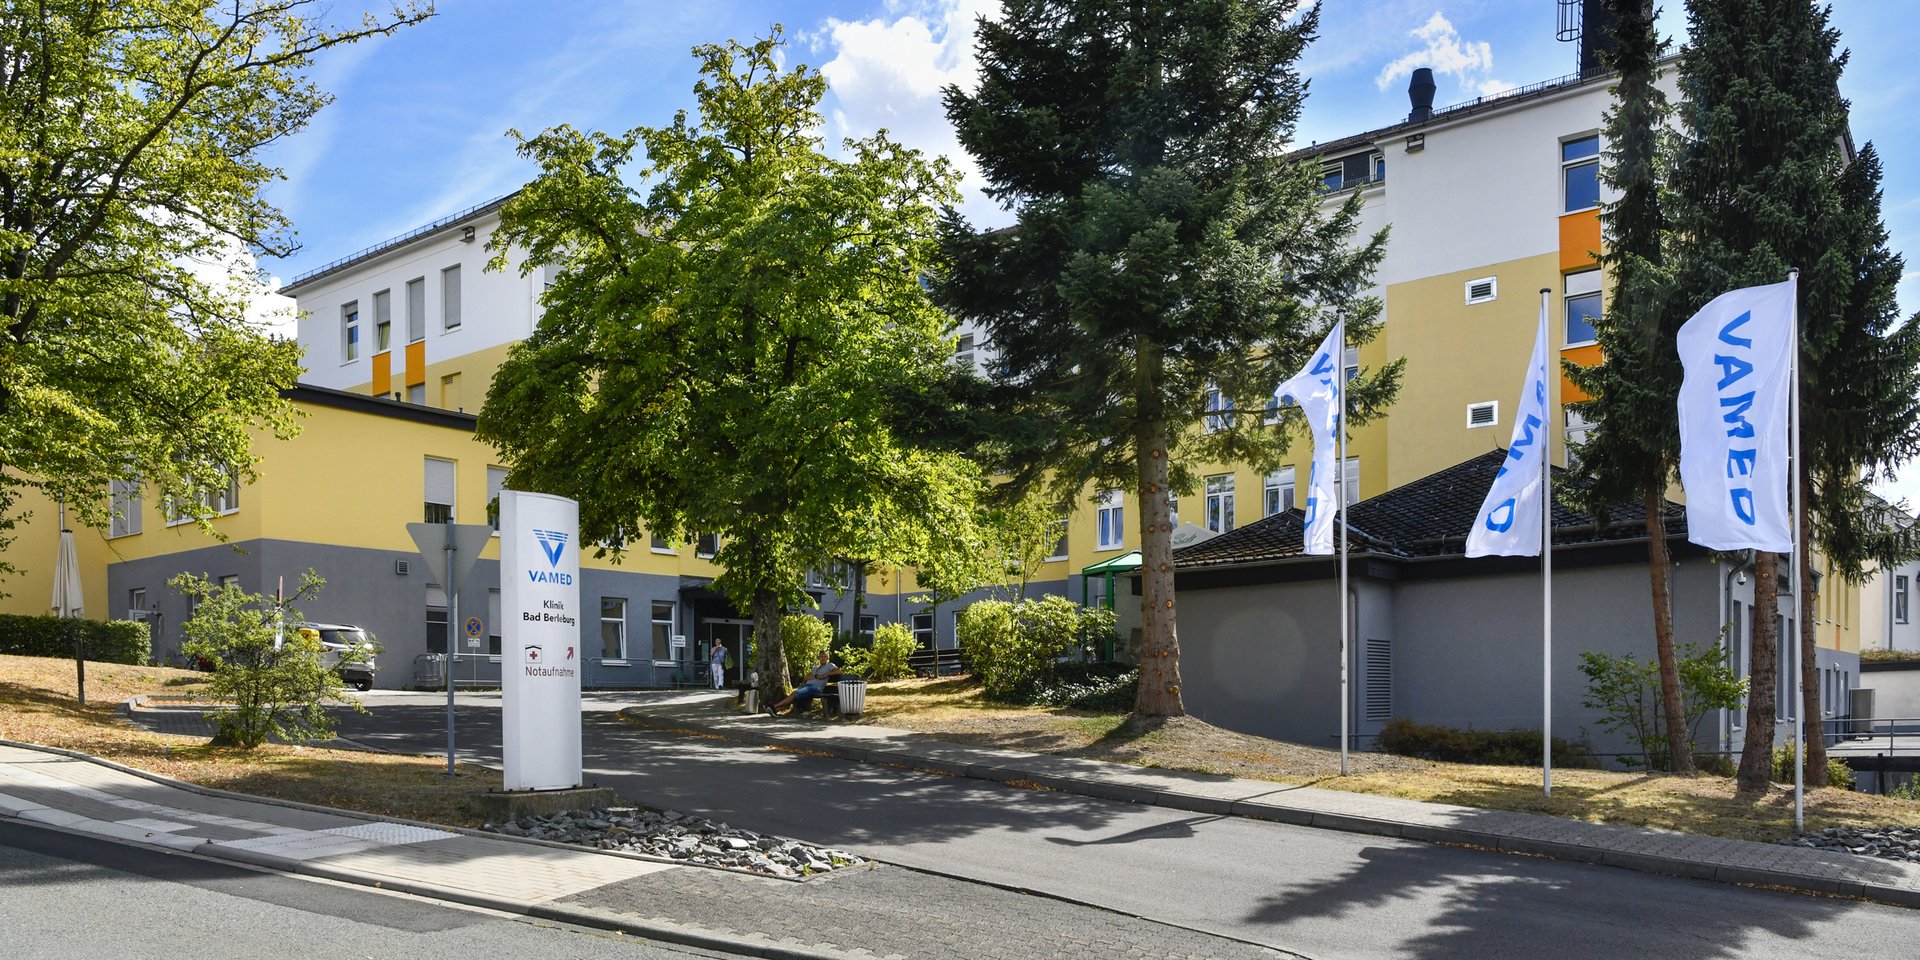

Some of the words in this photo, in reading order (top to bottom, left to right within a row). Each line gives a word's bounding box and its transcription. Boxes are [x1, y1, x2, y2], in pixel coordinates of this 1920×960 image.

[1714, 310, 1757, 526] VAMED
[528, 569, 573, 586] VAMED
[543, 599, 564, 610] Klinik
[523, 612, 541, 622] Bad
[543, 613, 575, 627] Berleburg
[525, 666, 574, 678] Notaufnahme
